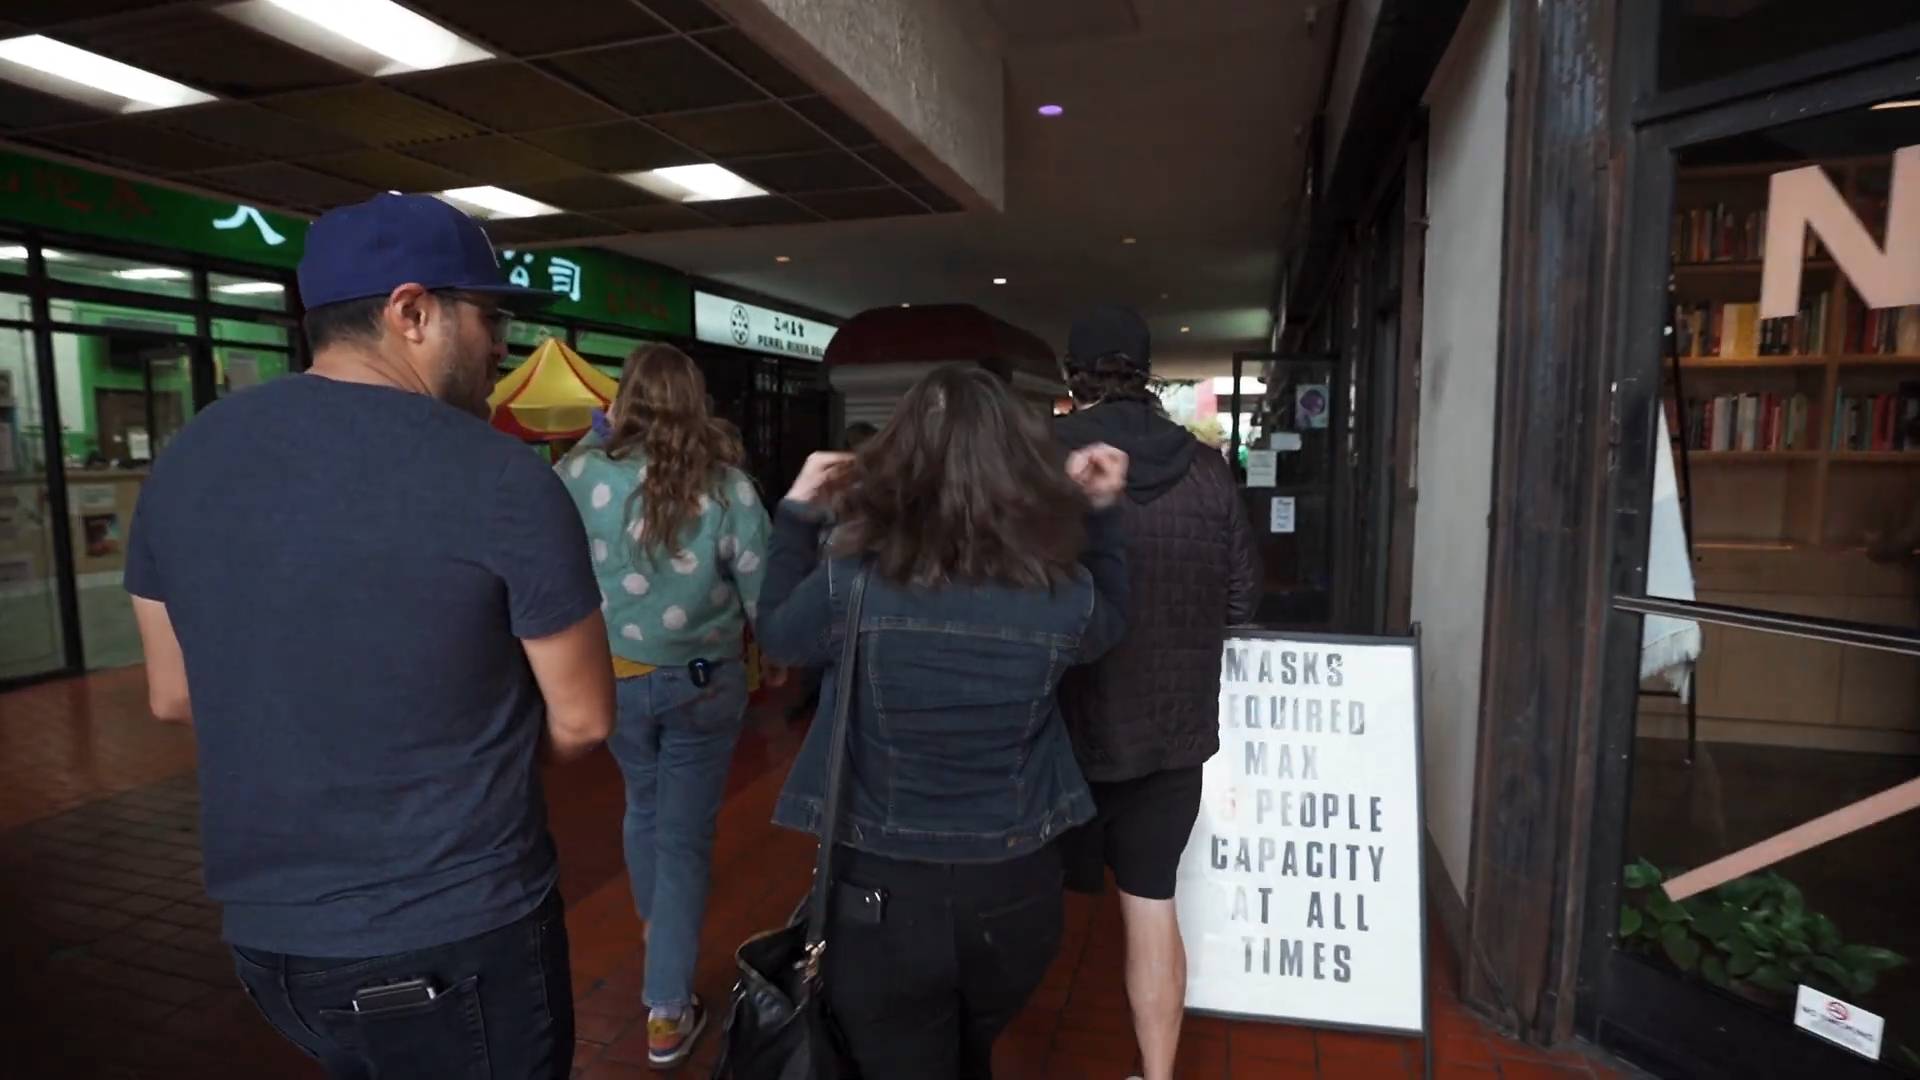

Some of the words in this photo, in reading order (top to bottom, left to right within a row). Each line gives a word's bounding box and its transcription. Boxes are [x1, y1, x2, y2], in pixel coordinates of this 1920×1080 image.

[1226, 648, 1343, 686] MASKS
[1228, 694, 1365, 735] EQUIRED
[1245, 741, 1318, 780] MAX
[1256, 789, 1382, 832] PEOPLE
[1211, 834, 1384, 882] CAPACITY
[1231, 885, 1273, 924] AT
[1307, 891, 1369, 931] ALL
[1241, 936, 1351, 983] TIMES
